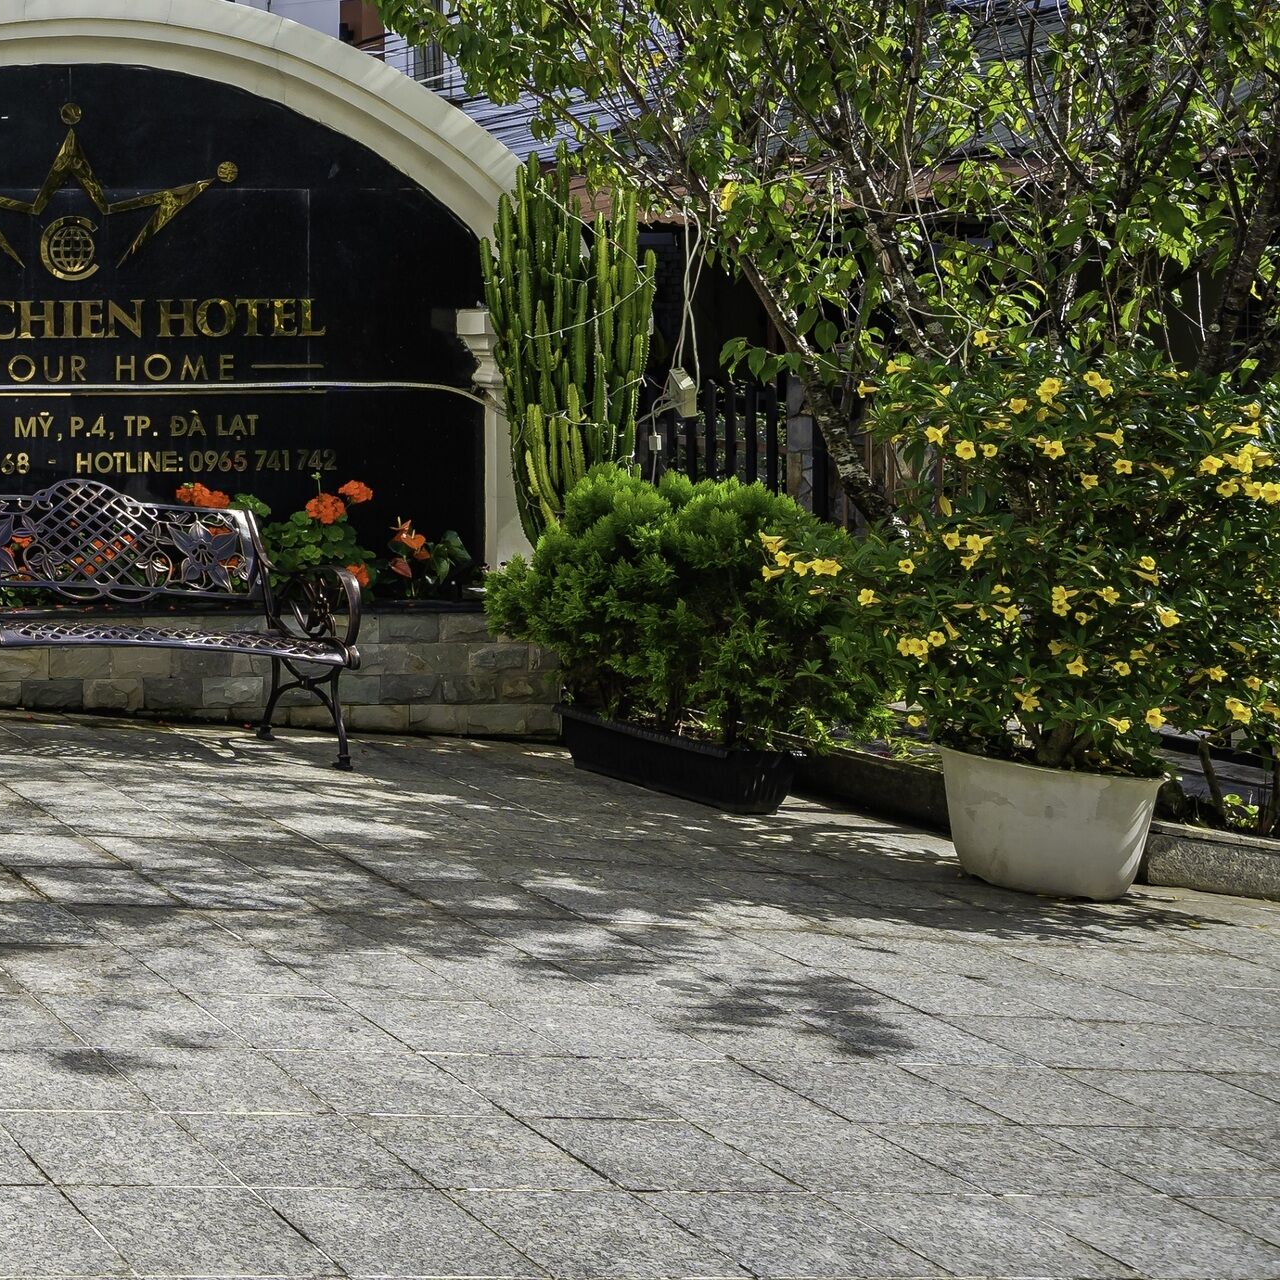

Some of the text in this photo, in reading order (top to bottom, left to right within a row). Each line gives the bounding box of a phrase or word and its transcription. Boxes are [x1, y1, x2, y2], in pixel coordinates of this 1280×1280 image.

[156, 297, 327, 338] HOTEL
[115, 353, 235, 382] HOME
[123, 415, 158, 437] TP.
[169, 409, 207, 437] ĐÀ
[216, 414, 259, 440] LẠT
[75, 450, 184, 473] HOTLINE:
[190, 449, 248, 473] 0965
